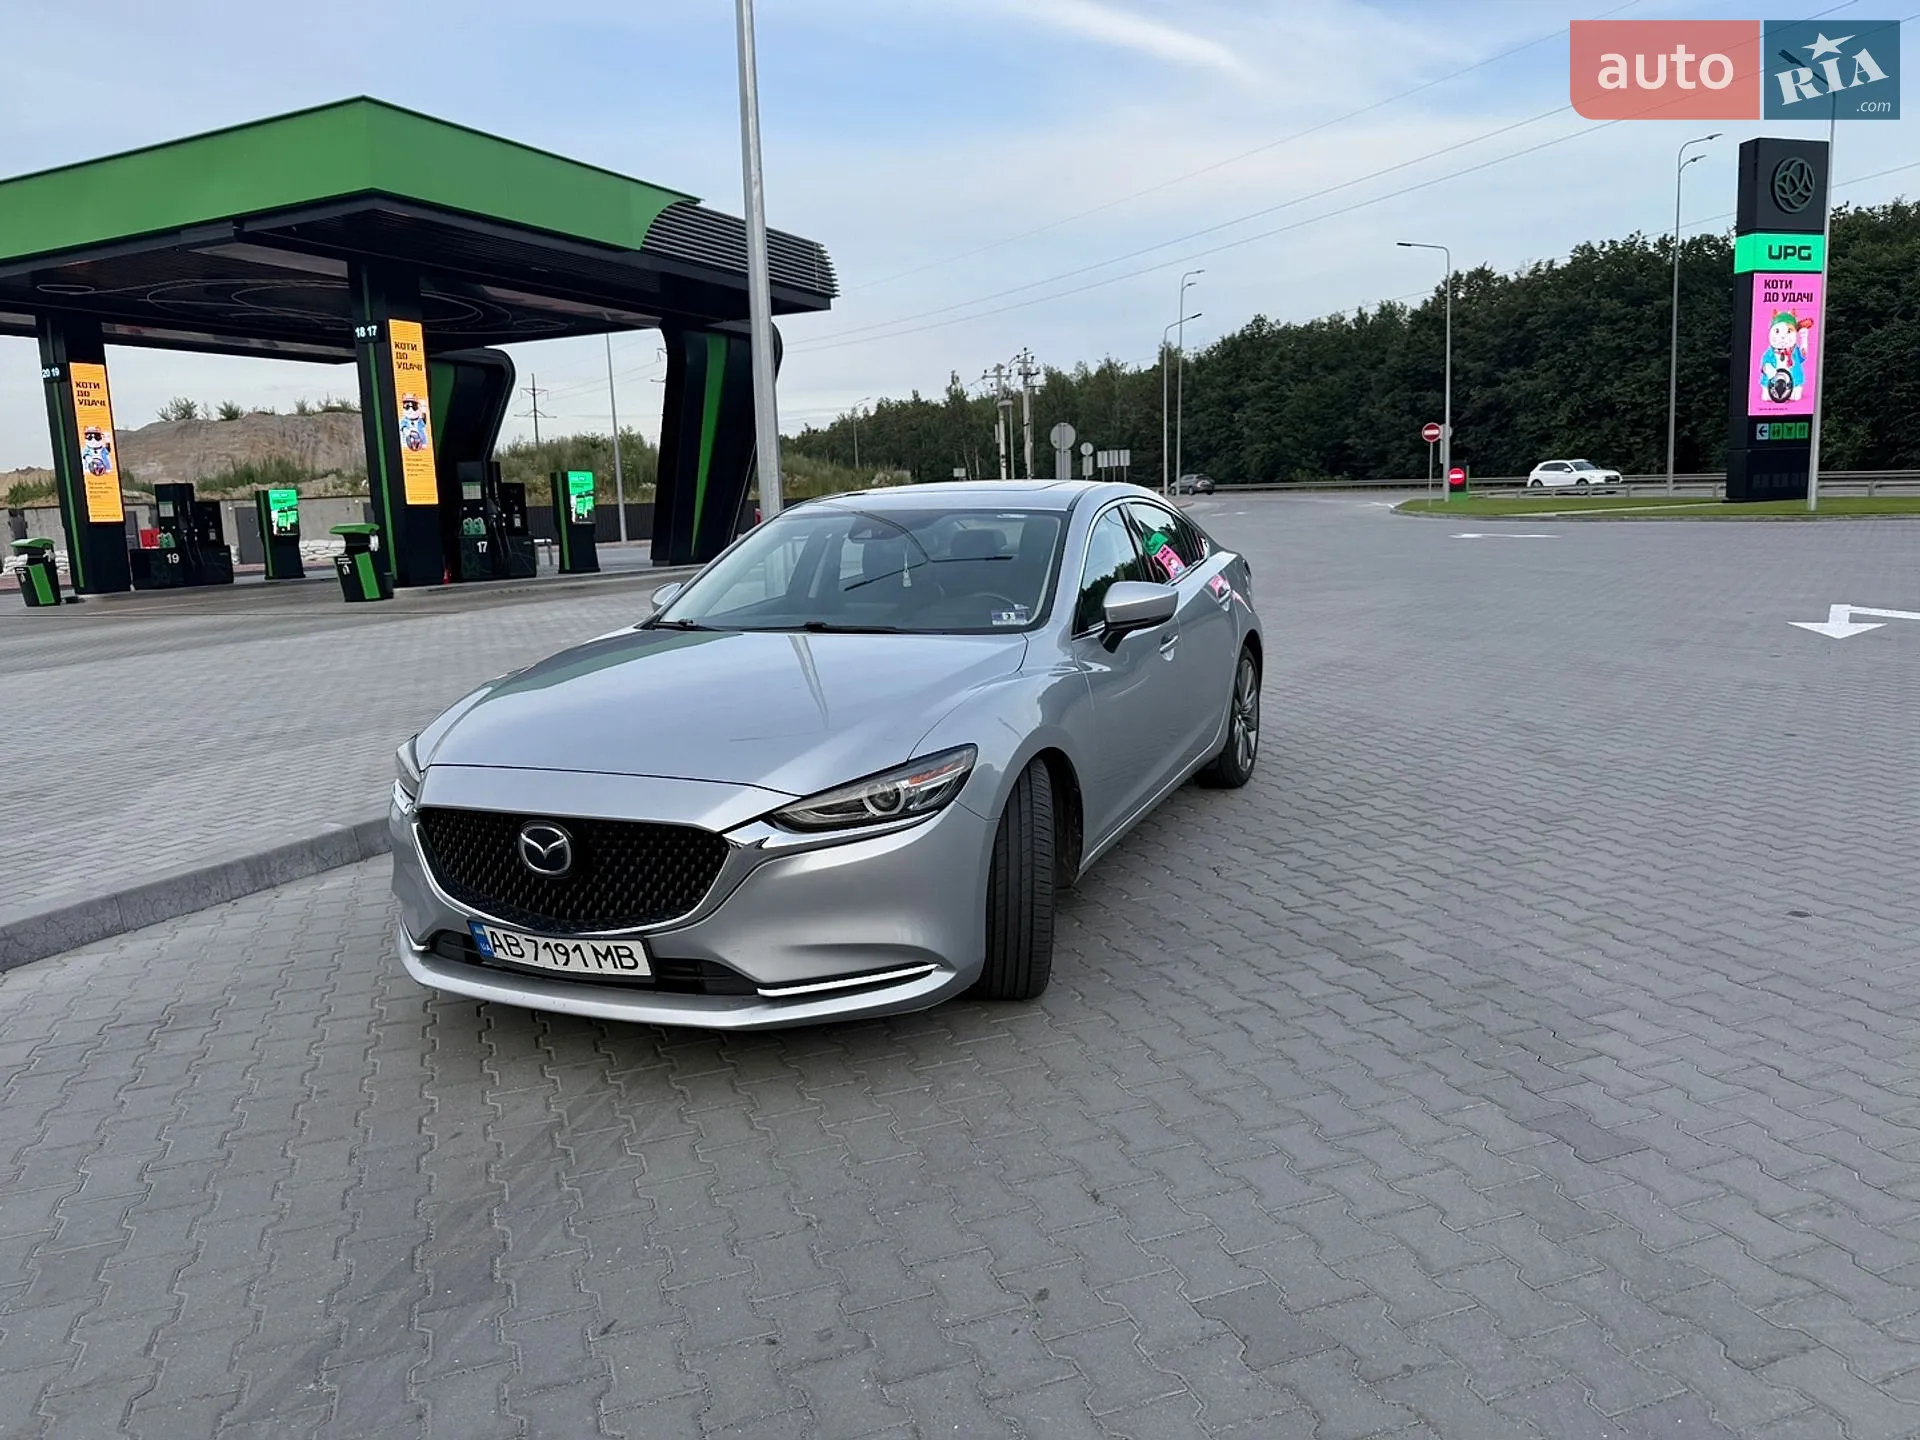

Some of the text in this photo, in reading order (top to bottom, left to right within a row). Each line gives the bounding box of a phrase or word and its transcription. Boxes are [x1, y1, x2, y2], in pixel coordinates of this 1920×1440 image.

[1767, 245, 1812, 261] UPG
[1764, 279, 1793, 289] КОТИ
[1763, 292, 1813, 303] ДО УДАЧІ
[355, 325, 377, 338] 18 17
[394, 341, 417, 351] КОТИ
[395, 351, 408, 360] ДО
[396, 361, 423, 371] УДАЧІ
[76, 381, 100, 390] КОТИ
[77, 390, 91, 398] ДО
[477, 541, 488, 553] 17
[166, 553, 180, 564] 19
